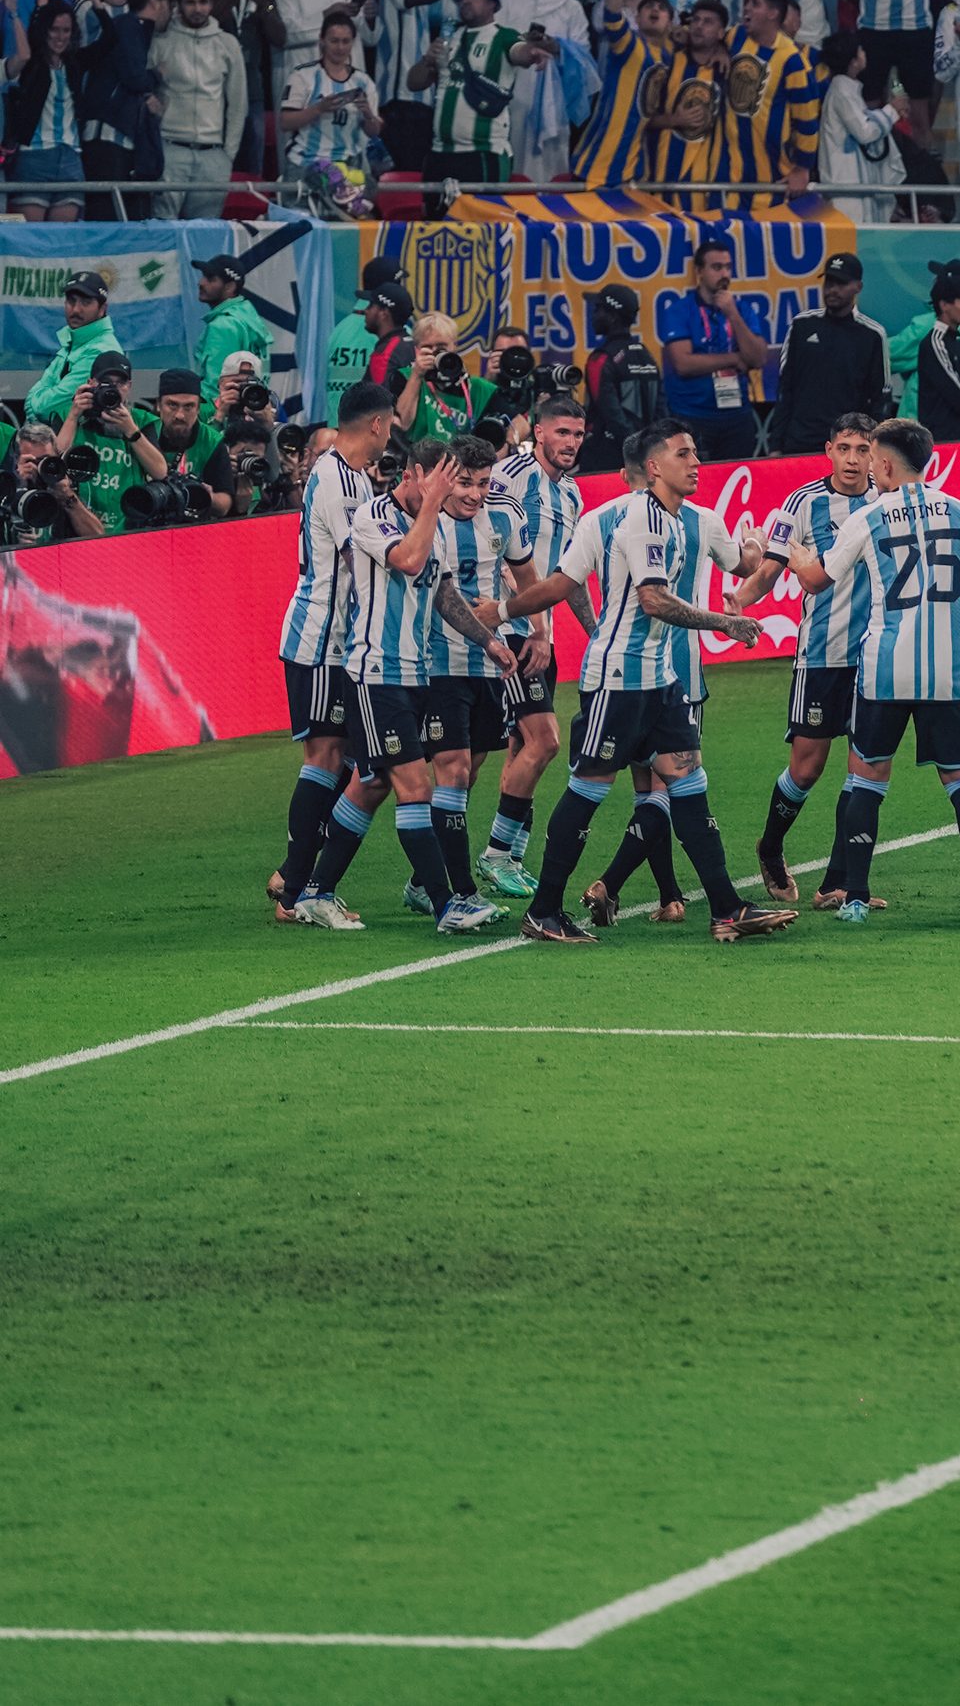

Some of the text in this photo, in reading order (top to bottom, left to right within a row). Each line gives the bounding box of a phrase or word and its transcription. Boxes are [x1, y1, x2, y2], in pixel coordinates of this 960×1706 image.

[332, 108, 349, 127] 10
[418, 229, 474, 259] CARC
[526, 293, 578, 351] ES
[331, 348, 368, 367] 4511
[881, 502, 951, 526] MARTINEZ
[458, 558, 479, 585] 9
